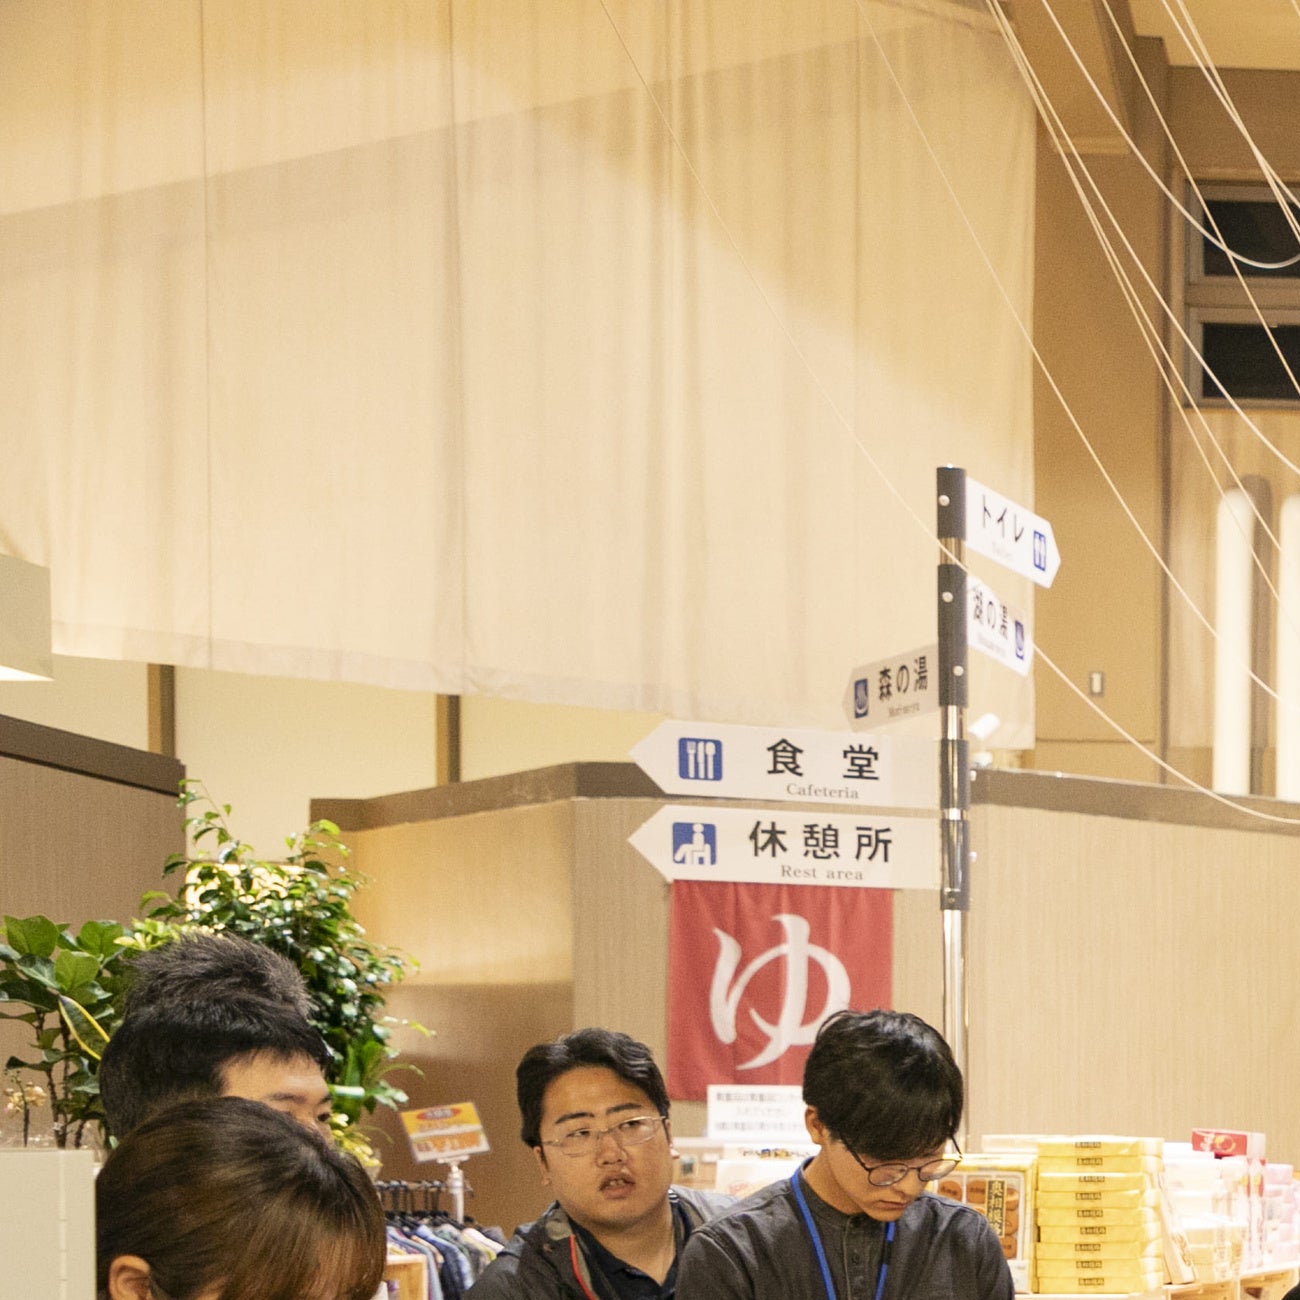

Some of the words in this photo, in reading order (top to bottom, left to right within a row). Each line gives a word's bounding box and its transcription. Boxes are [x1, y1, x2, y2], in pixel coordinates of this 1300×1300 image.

[981, 493, 1026, 542] トイレ
[878, 655, 929, 702] 森の湯
[766, 738, 880, 780] 食堂
[786, 782, 860, 800] Cafeteria
[749, 820, 893, 863] 休憩所
[780, 864, 818, 880] Rest
[826, 868, 865, 881] area
[709, 913, 851, 1070] ゆ
